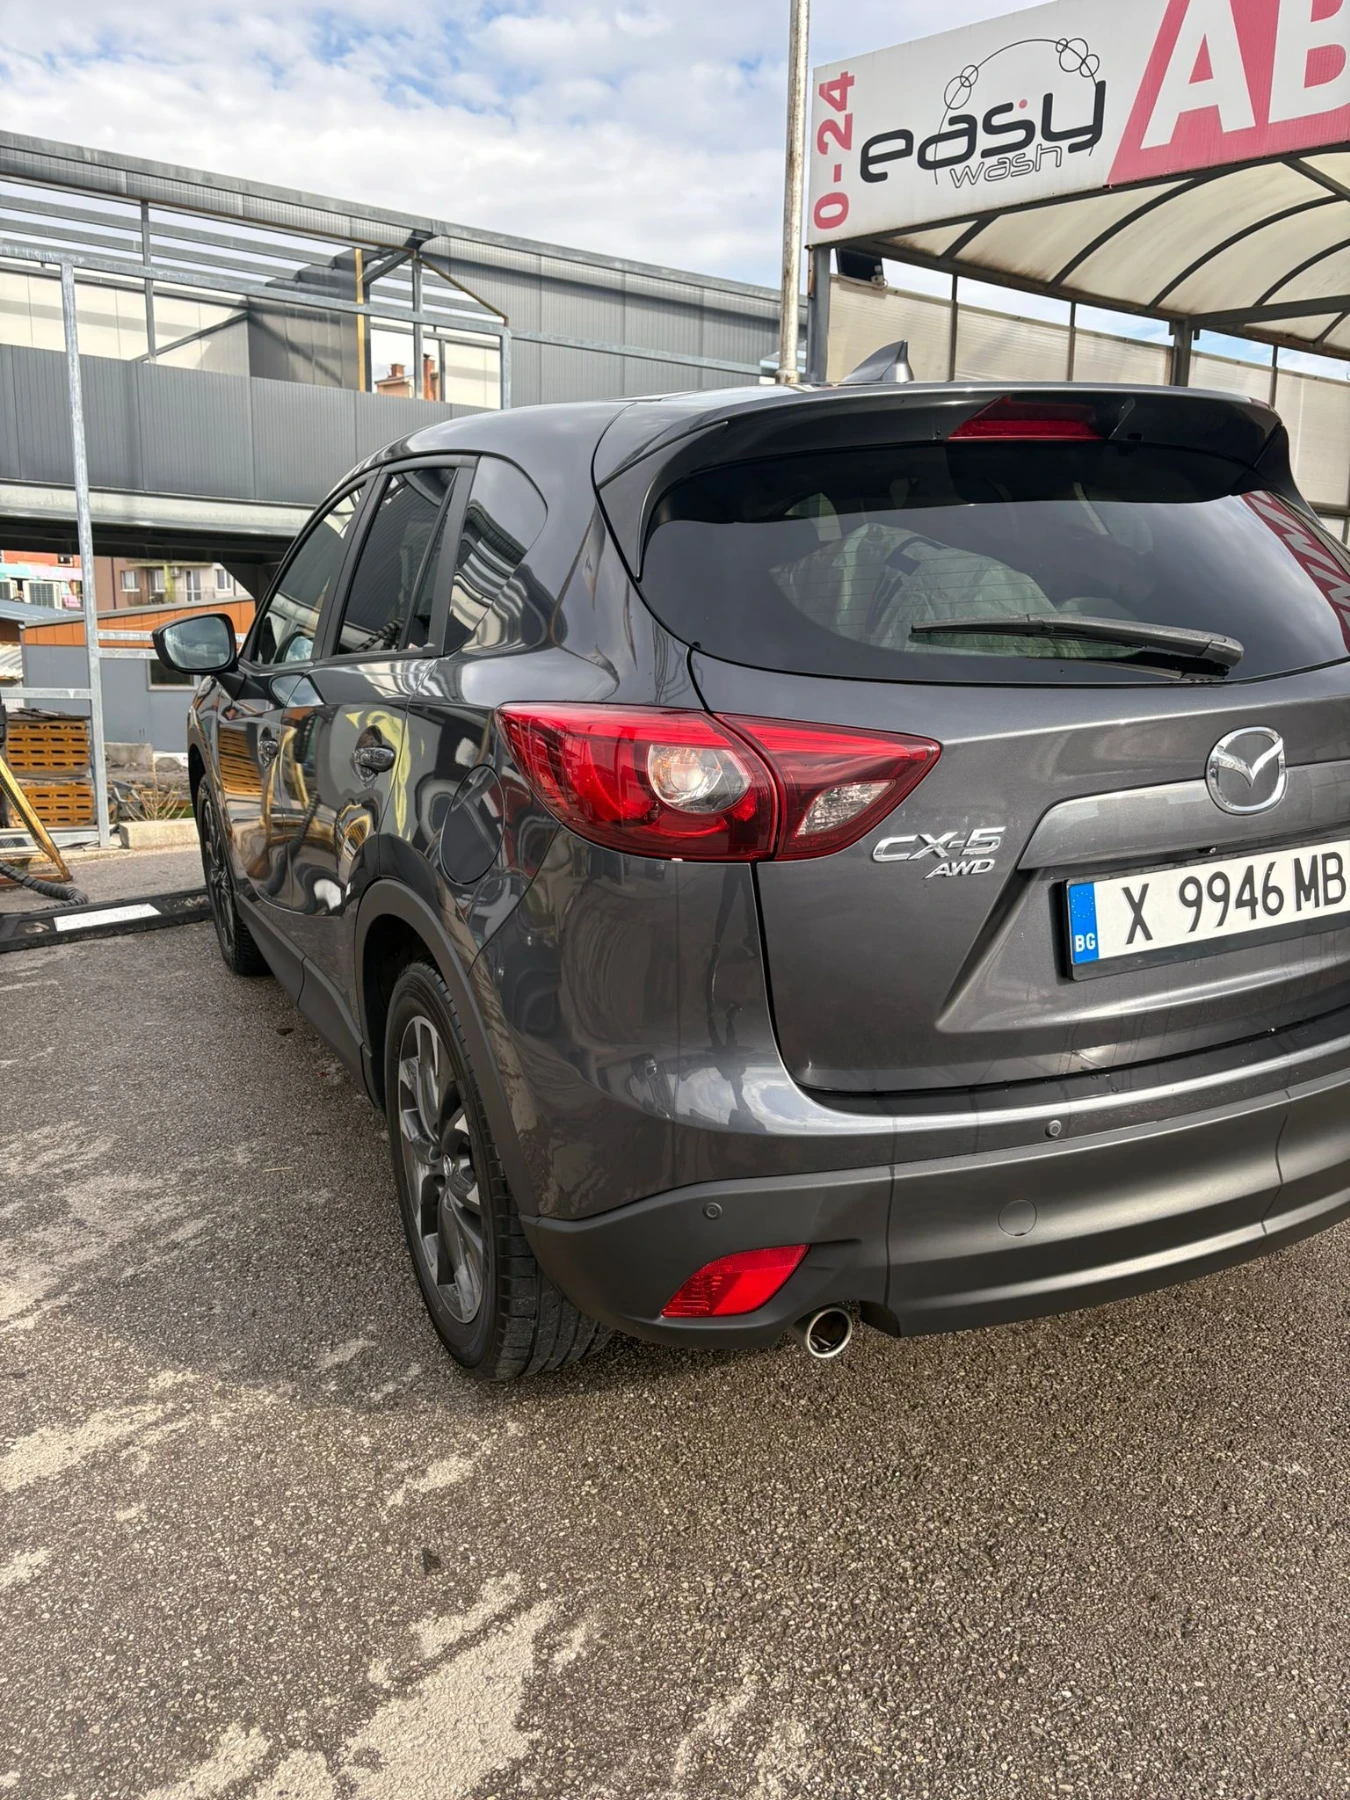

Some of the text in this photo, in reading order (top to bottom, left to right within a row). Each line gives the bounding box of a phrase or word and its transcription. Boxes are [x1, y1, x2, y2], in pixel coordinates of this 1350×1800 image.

[860, 80, 1107, 183] easy
[950, 143, 1063, 189] wash
[872, 826, 1007, 862] CX-5
[922, 858, 996, 879] AWD
[1122, 851, 1347, 945] X 9946 MB
[1075, 932, 1097, 952] BG
